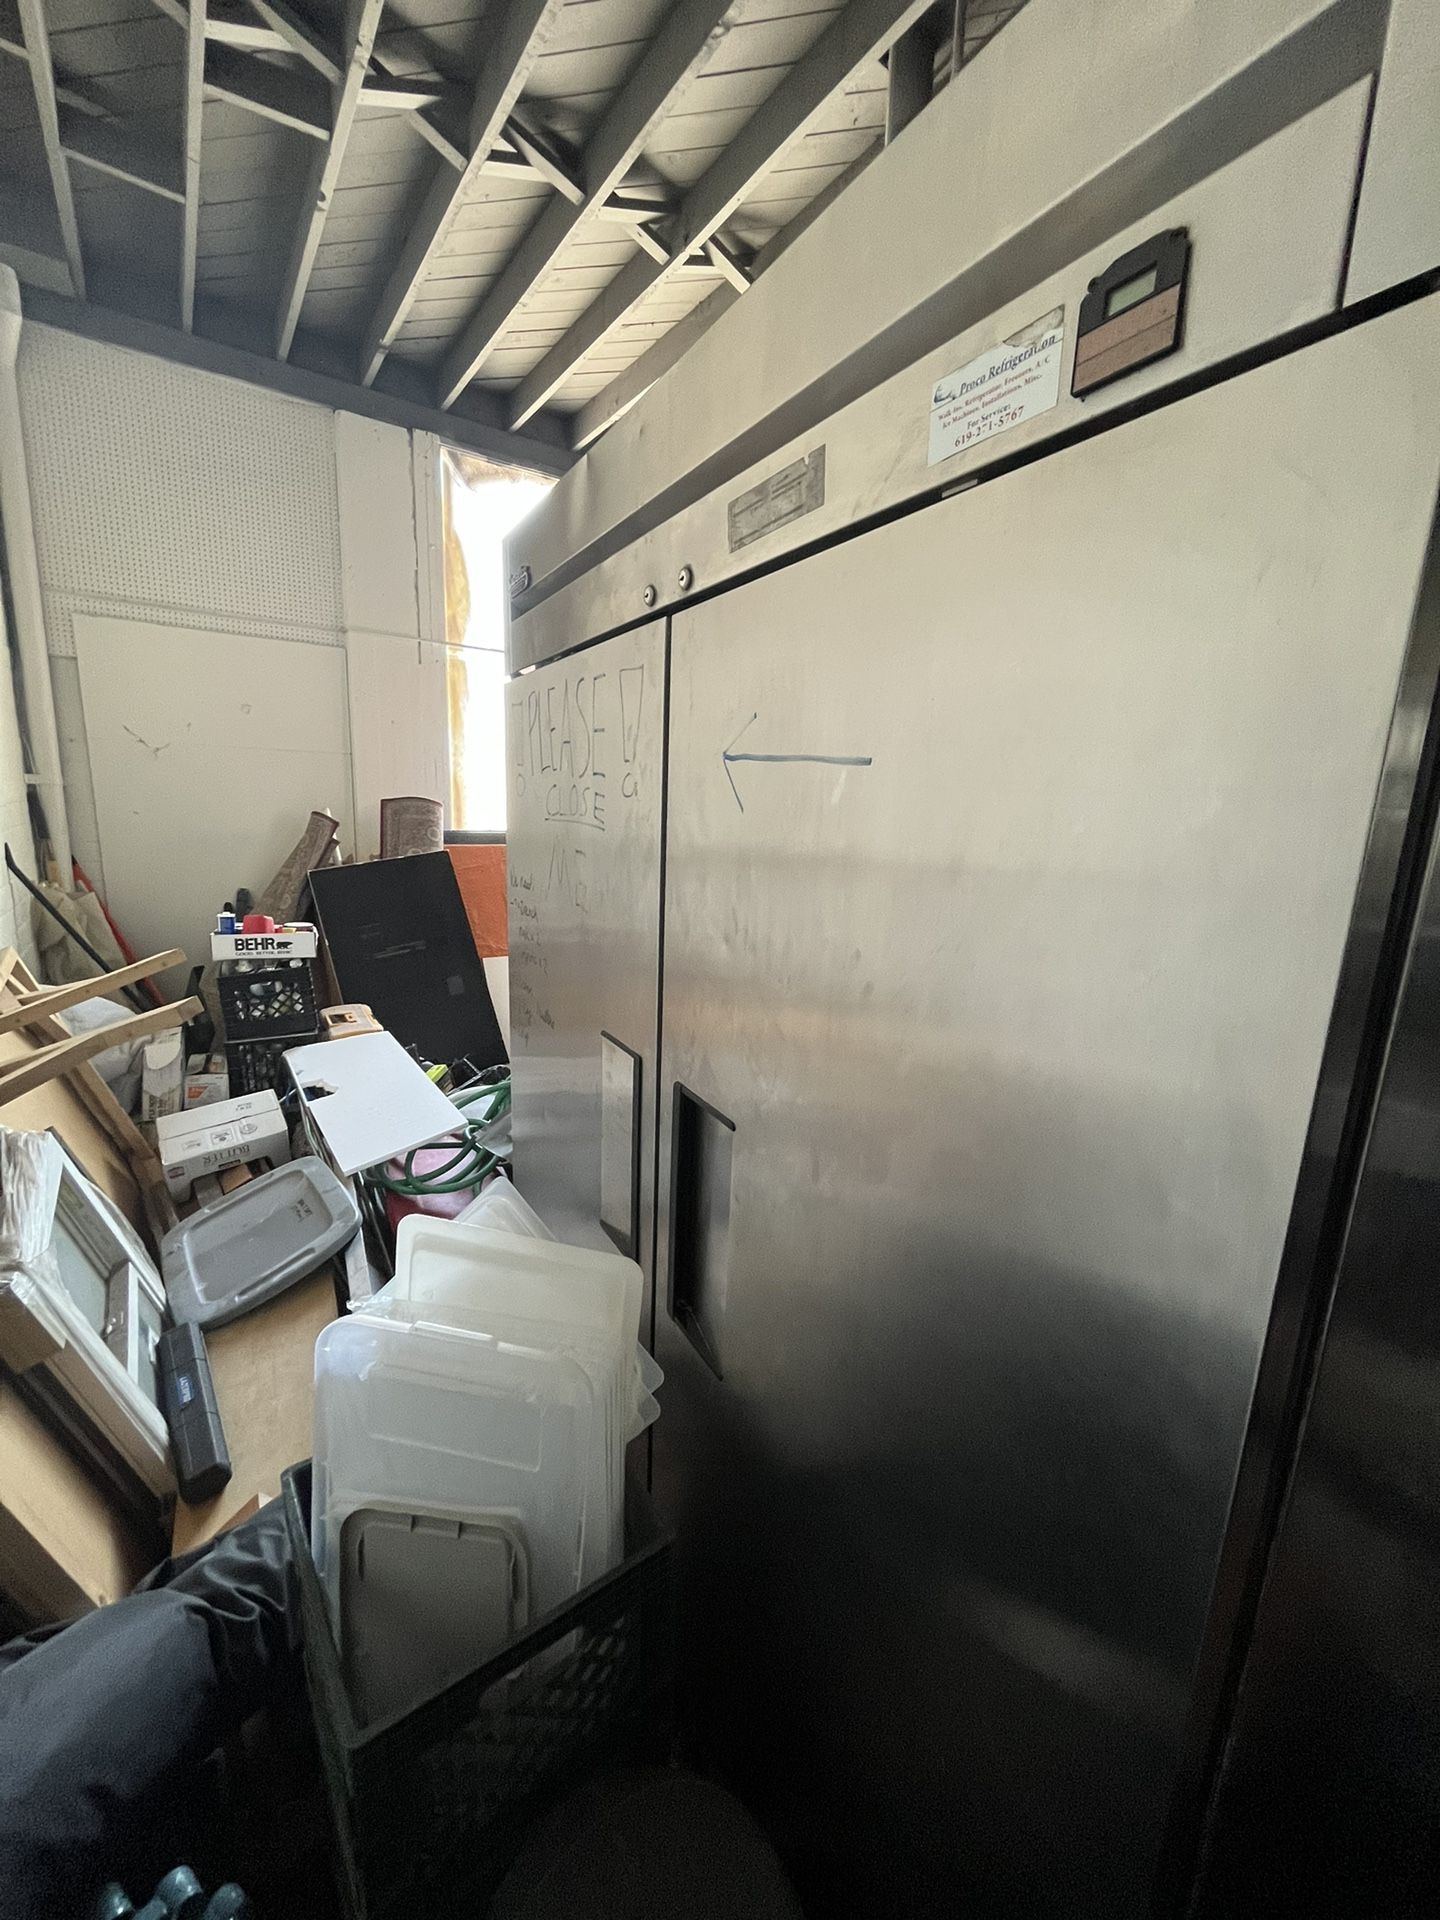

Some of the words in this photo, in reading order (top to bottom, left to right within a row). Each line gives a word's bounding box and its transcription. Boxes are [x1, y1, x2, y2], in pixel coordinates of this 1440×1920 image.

[528, 673, 606, 779] PLEASE
[546, 784, 606, 825] CLOSE
[234, 937, 276, 951] BEHR
[202, 1144, 250, 1165] BUTTER
